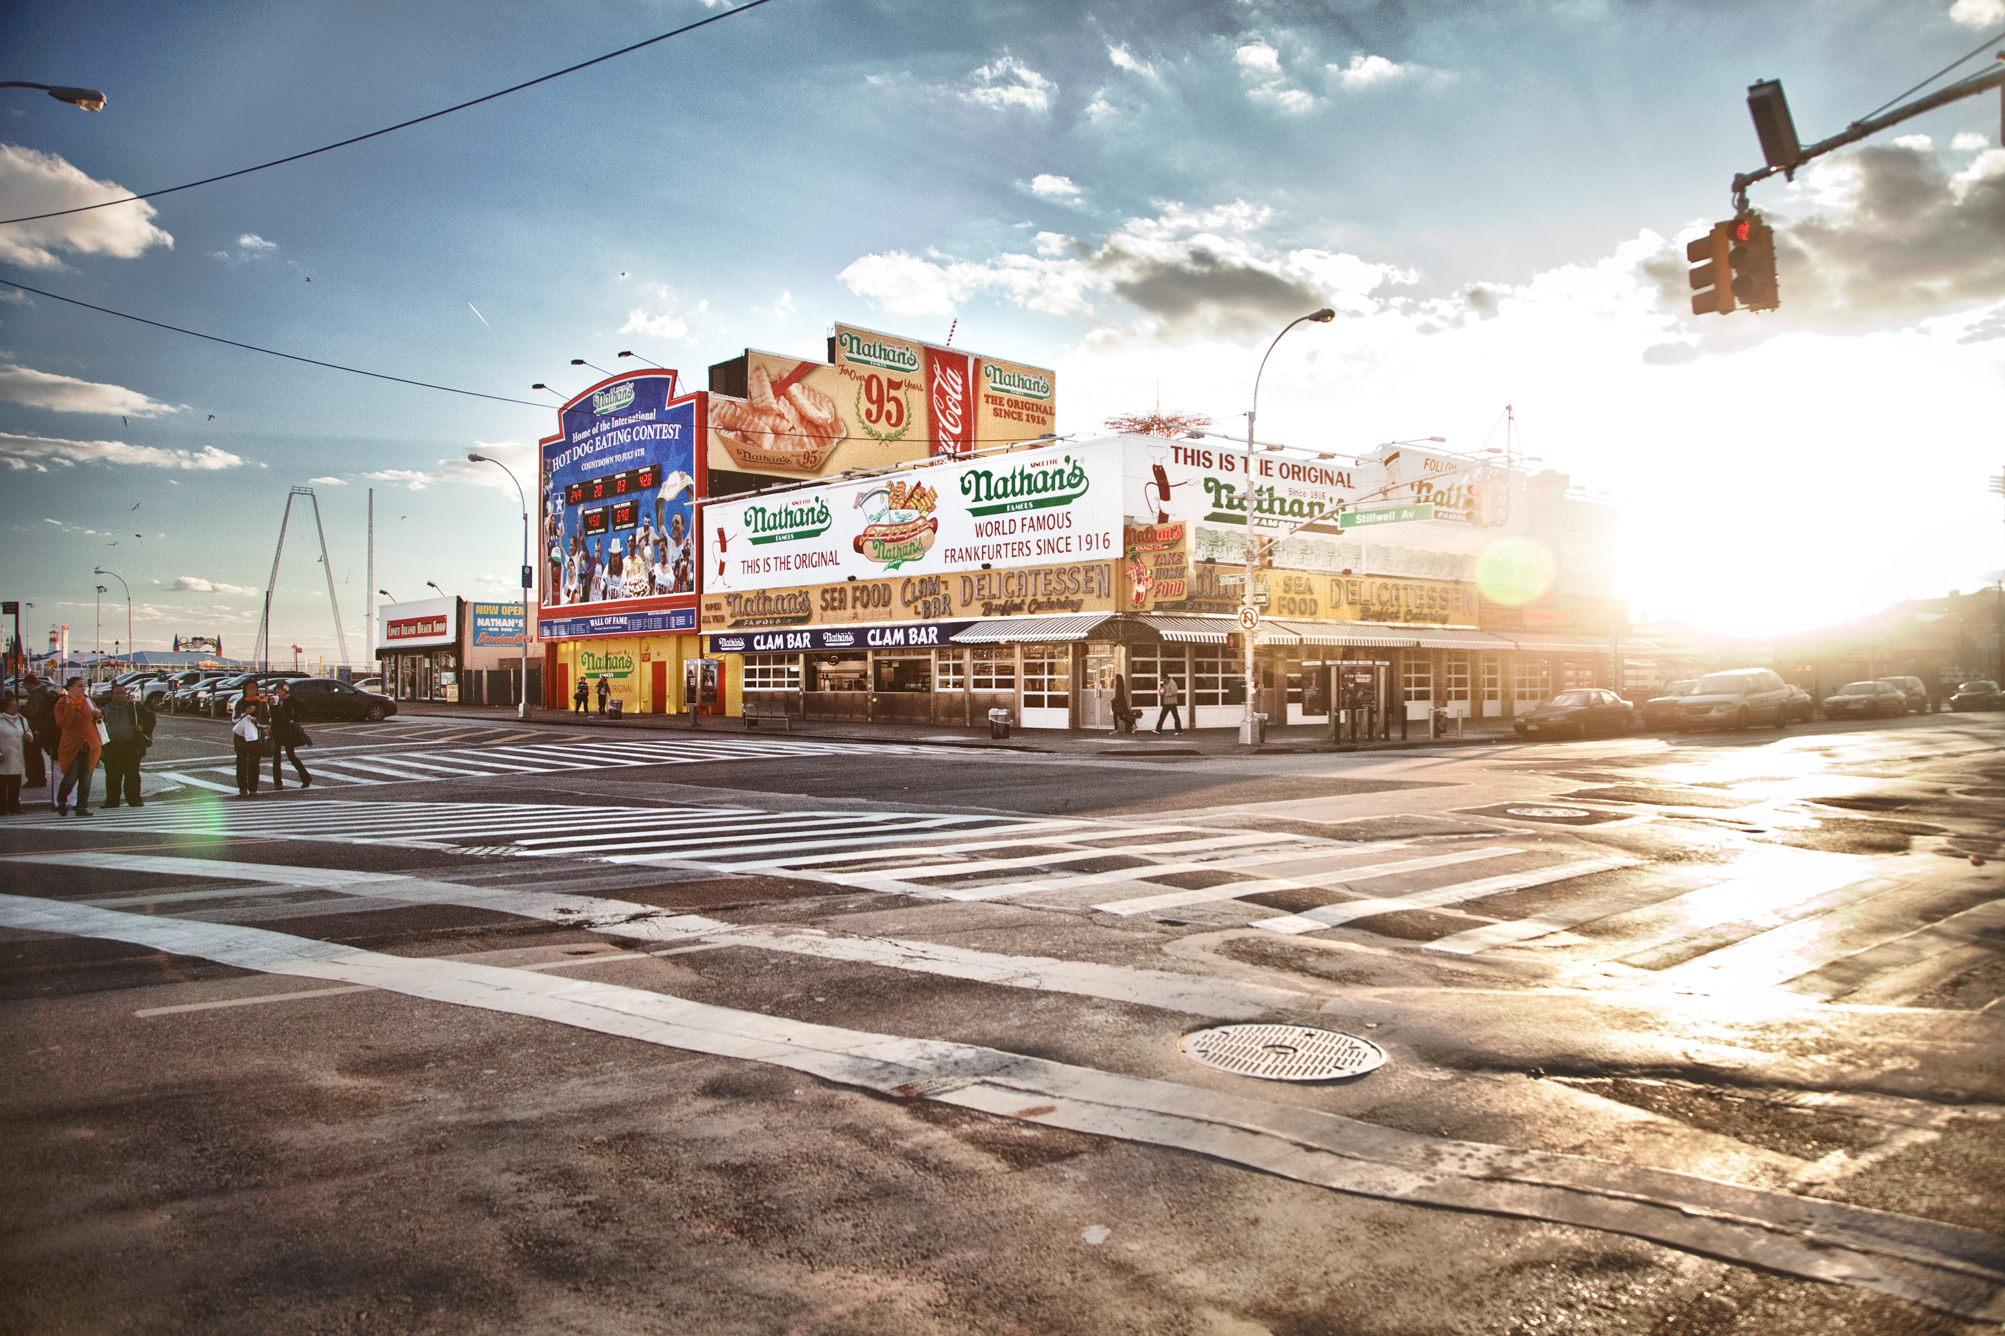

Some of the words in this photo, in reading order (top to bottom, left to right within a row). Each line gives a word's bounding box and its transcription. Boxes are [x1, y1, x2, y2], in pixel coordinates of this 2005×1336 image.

[838, 332, 918, 366] Nathan's
[984, 365, 1050, 394] Nathan's
[593, 381, 634, 409] Nathan's
[838, 364, 850, 375] For
[850, 369, 866, 383] Over
[865, 373, 904, 428] 95
[904, 379, 924, 391] Years
[984, 394, 1004, 407] THE
[1007, 398, 1055, 416] ORIGINAL
[572, 431, 591, 444] Home
[592, 423, 600, 435] of
[600, 421, 611, 432] the
[611, 409, 656, 428] International
[993, 407, 1023, 421] SINCE
[1026, 413, 1047, 425] 1916
[552, 449, 572, 472] HOT
[572, 440, 594, 461] DOG
[595, 429, 632, 451] EATING
[632, 424, 682, 444] CONTEST
[736, 448, 793, 464] Nathan's
[802, 450, 819, 465] 95
[581, 455, 614, 471] COUNTDOWN
[614, 453, 622, 463] TO
[622, 450, 634, 463] JULY
[634, 448, 645, 457] 4TH
[1170, 446, 1213, 469] THIS
[1219, 453, 1235, 472] IS
[1279, 462, 1356, 490] ORIGINAL
[593, 485, 603, 498] 20
[616, 479, 626, 493] 03
[960, 455, 1086, 503] Nathan's
[1288, 487, 1306, 498] Since
[1310, 490, 1326, 500] 1916
[744, 496, 830, 534] Nathan's
[1006, 501, 1034, 512] FAMOUS
[1354, 512, 1396, 524] Stillwell
[1401, 509, 1415, 519] Av
[974, 518, 1017, 539] WORLD
[1021, 511, 1072, 534] FAMOUS
[1124, 525, 1183, 546] Nathan's
[775, 534, 794, 542] FAMOUS
[873, 536, 925, 560] Nathan's
[944, 540, 1032, 565] FRANKFURTERS
[1036, 536, 1072, 556] SINCE
[1077, 532, 1111, 552] 1916
[741, 559, 761, 575] THIS
[763, 557, 771, 573] IS
[773, 555, 791, 572] THE
[794, 550, 840, 571] ORIGINAL
[1152, 552, 1184, 566] TAKE
[1154, 566, 1187, 580] HOME
[901, 575, 941, 608] CLAM
[960, 563, 1110, 606] DELICATESSEN
[1152, 580, 1184, 598] FOOD
[1282, 576, 1315, 595] SEA
[724, 590, 811, 617] Nathan's
[820, 586, 847, 611] SEA
[851, 583, 892, 609] FOOD
[921, 593, 953, 619] BAR
[981, 600, 1025, 616] Buffet
[1027, 597, 1084, 615] Catering
[1278, 596, 1318, 616] FOOD
[1330, 578, 1475, 616] DELICATESSEN
[475, 605, 499, 615] NOW
[501, 605, 523, 616] OPEN
[590, 617, 604, 627] WALL
[604, 616, 612, 625] OF
[612, 616, 628, 625] FAME
[1360, 606, 1401, 622] Buffet
[477, 618, 524, 627] NATHAN'S
[719, 637, 744, 648] Nathan's
[753, 634, 783, 650] CLAM
[786, 632, 811, 649] BAR
[823, 631, 854, 644] Nathan's
[867, 628, 904, 646] CLAM
[908, 626, 939, 645] BAR
[580, 650, 633, 670] Nathan's
